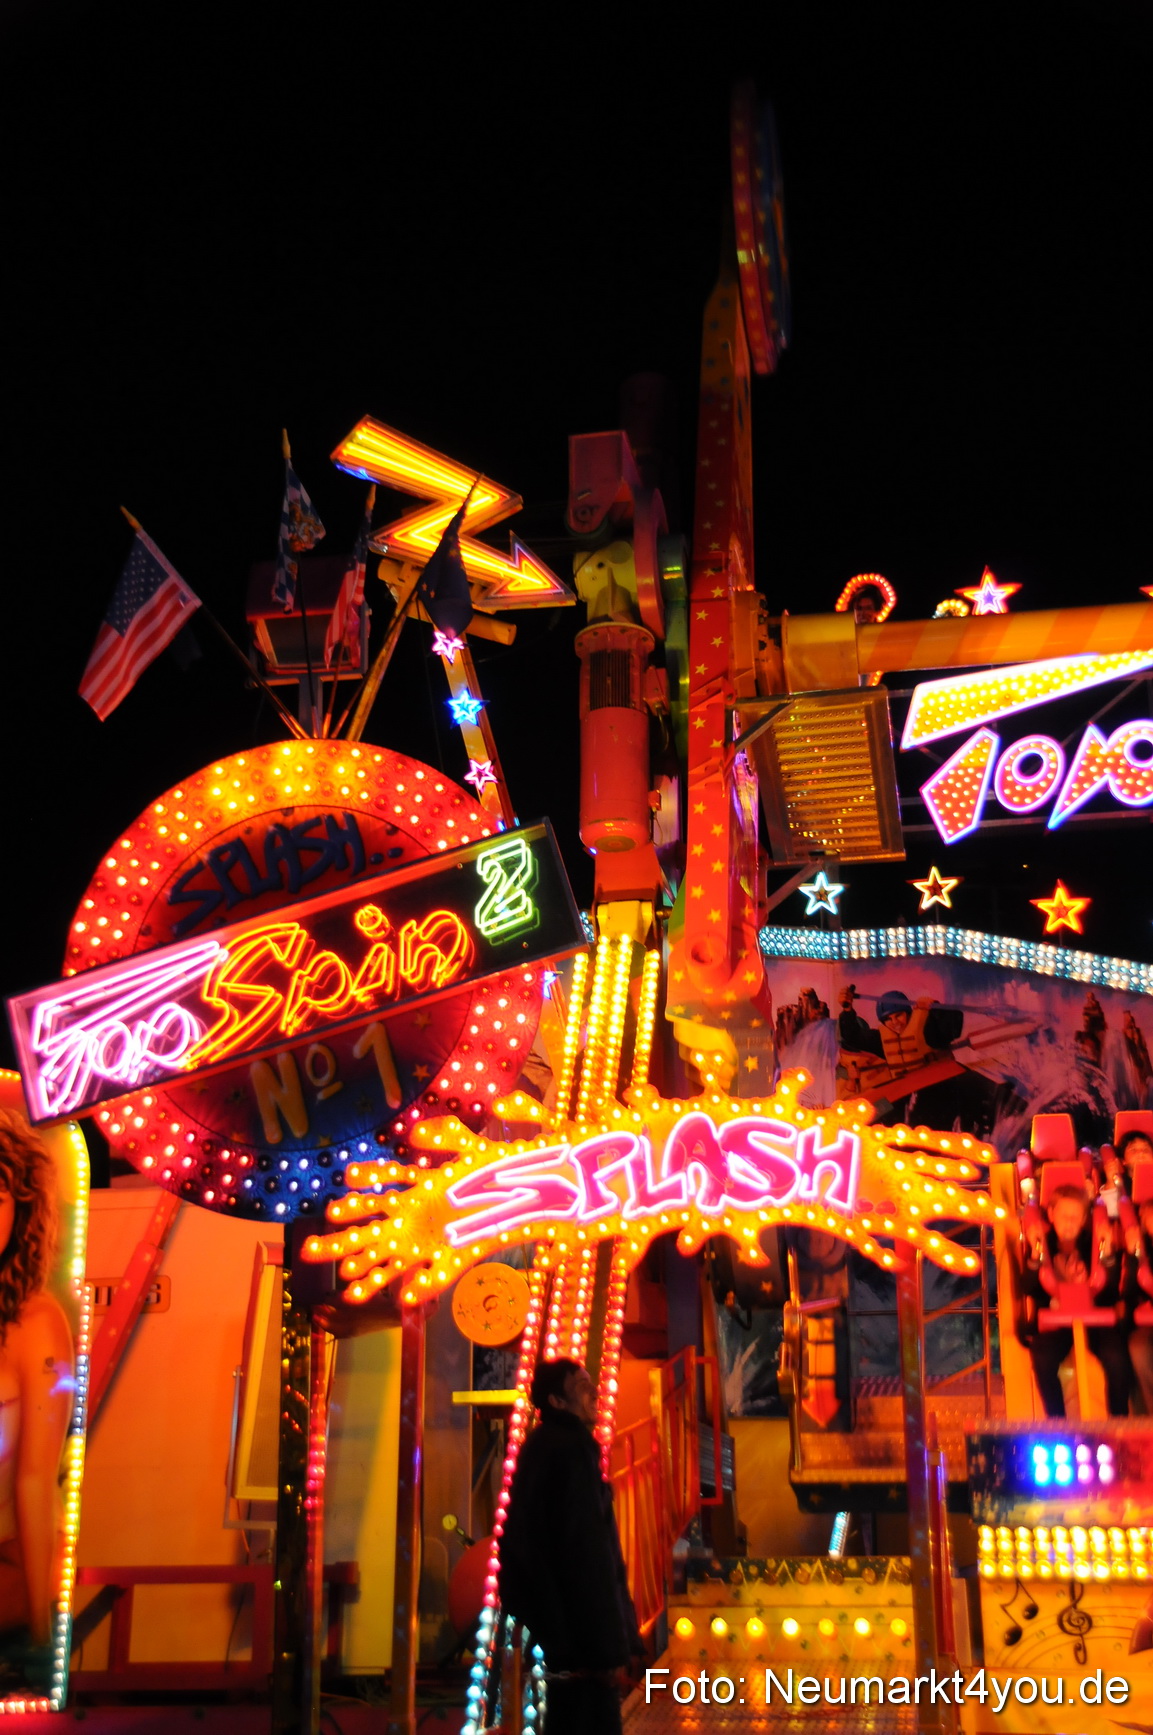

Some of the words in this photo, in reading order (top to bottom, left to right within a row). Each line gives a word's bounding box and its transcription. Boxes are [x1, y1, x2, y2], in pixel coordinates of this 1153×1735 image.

[180, 904, 473, 1071] Spin
[474, 837, 539, 938] 2
[445, 1111, 860, 1246] SPLASH
